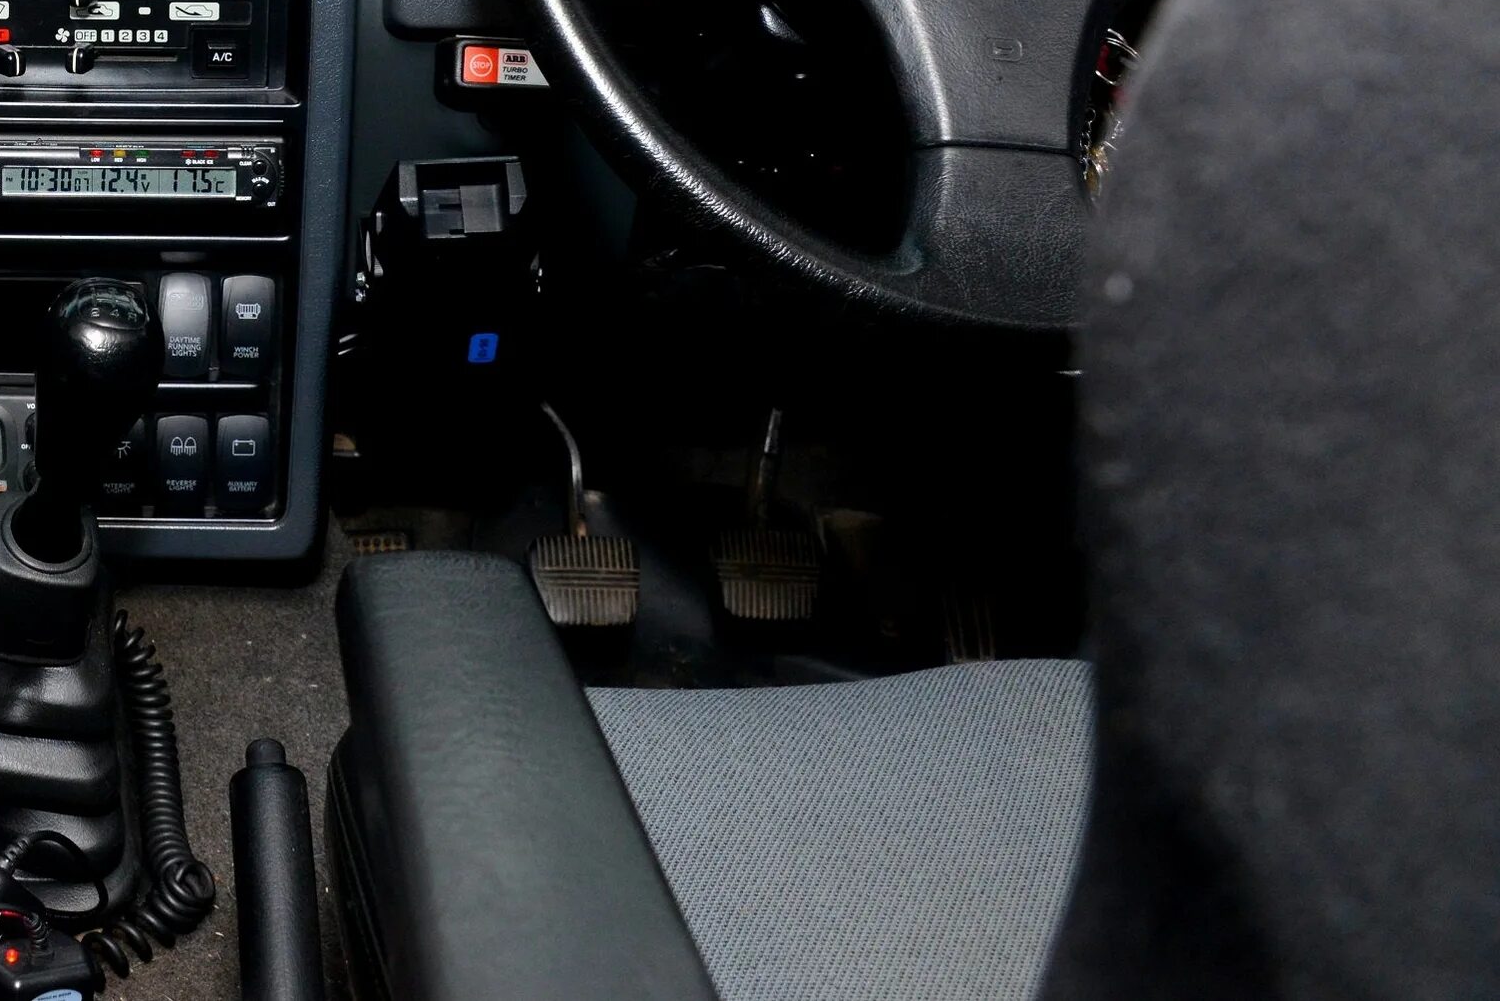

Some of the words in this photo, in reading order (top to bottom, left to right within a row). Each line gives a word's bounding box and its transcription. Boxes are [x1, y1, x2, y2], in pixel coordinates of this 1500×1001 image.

[75, 31, 96, 41] OFF
[122, 32, 129, 40] 2
[139, 32, 147, 40] 3
[157, 32, 165, 40] 4
[212, 52, 233, 62] A/C
[505, 55, 526, 63] ARB
[472, 61, 490, 69] STOP
[21, 168, 72, 191] 10:30
[75, 178, 89, 191] 07
[101, 169, 138, 192] 12.4
[141, 181, 150, 192] V
[173, 170, 212, 193] 17.5
